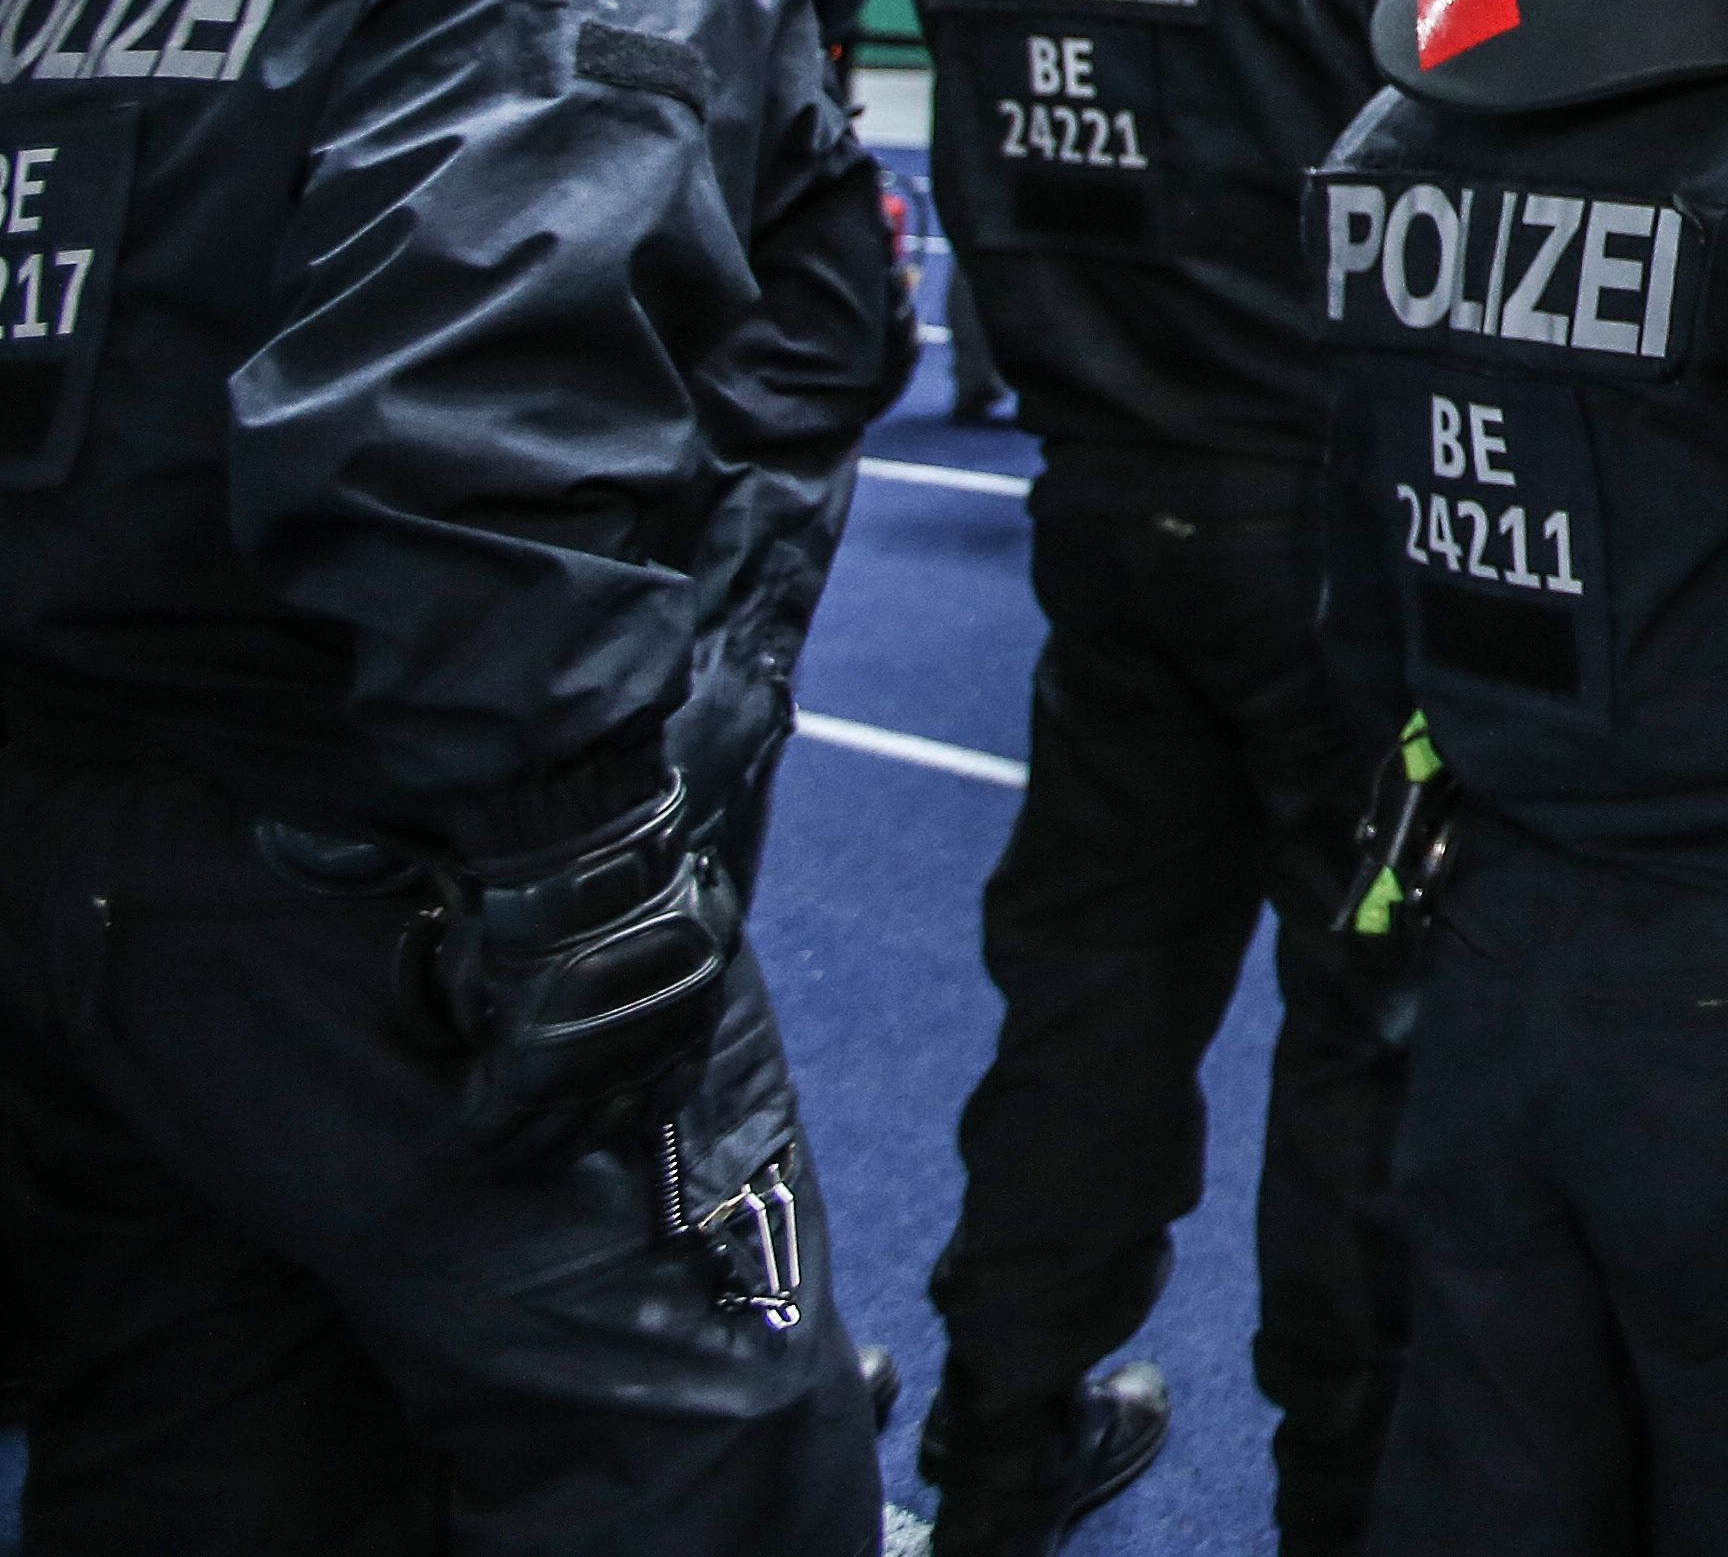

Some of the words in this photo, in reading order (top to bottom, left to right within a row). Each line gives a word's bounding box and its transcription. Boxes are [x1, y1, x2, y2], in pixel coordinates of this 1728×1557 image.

[1030, 37, 1095, 98] BE
[1001, 103, 1147, 168] 24221
[1327, 184, 1683, 358] POLIZEI
[1432, 395, 1516, 485] BE
[1397, 484, 1583, 594] 24211
